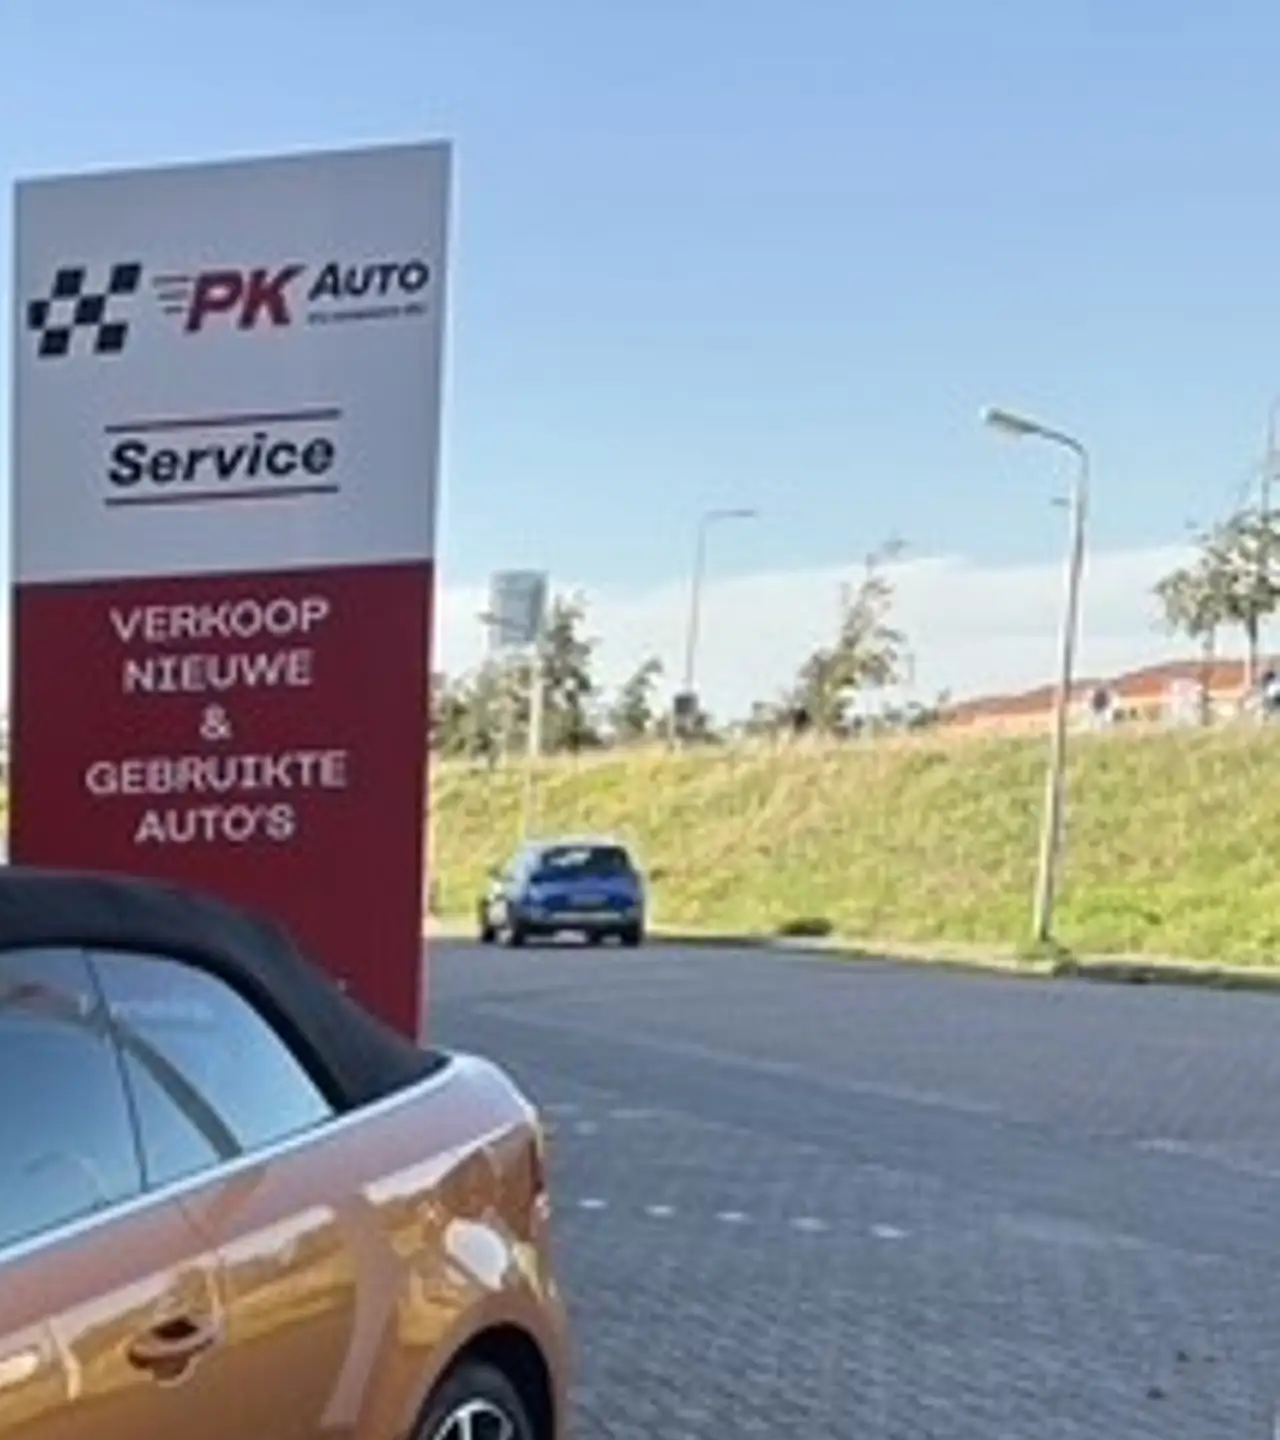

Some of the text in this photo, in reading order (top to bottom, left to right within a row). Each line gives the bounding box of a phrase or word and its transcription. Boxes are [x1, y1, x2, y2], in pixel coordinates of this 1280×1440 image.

[185, 259, 430, 333] PK AUTO
[108, 432, 335, 487] Service
[109, 597, 329, 642] VERKOOP
[123, 650, 315, 693] NIEUWE
[199, 704, 231, 740] &
[85, 750, 348, 795] GEBRUIKTE
[133, 804, 296, 844] AUTO'S
